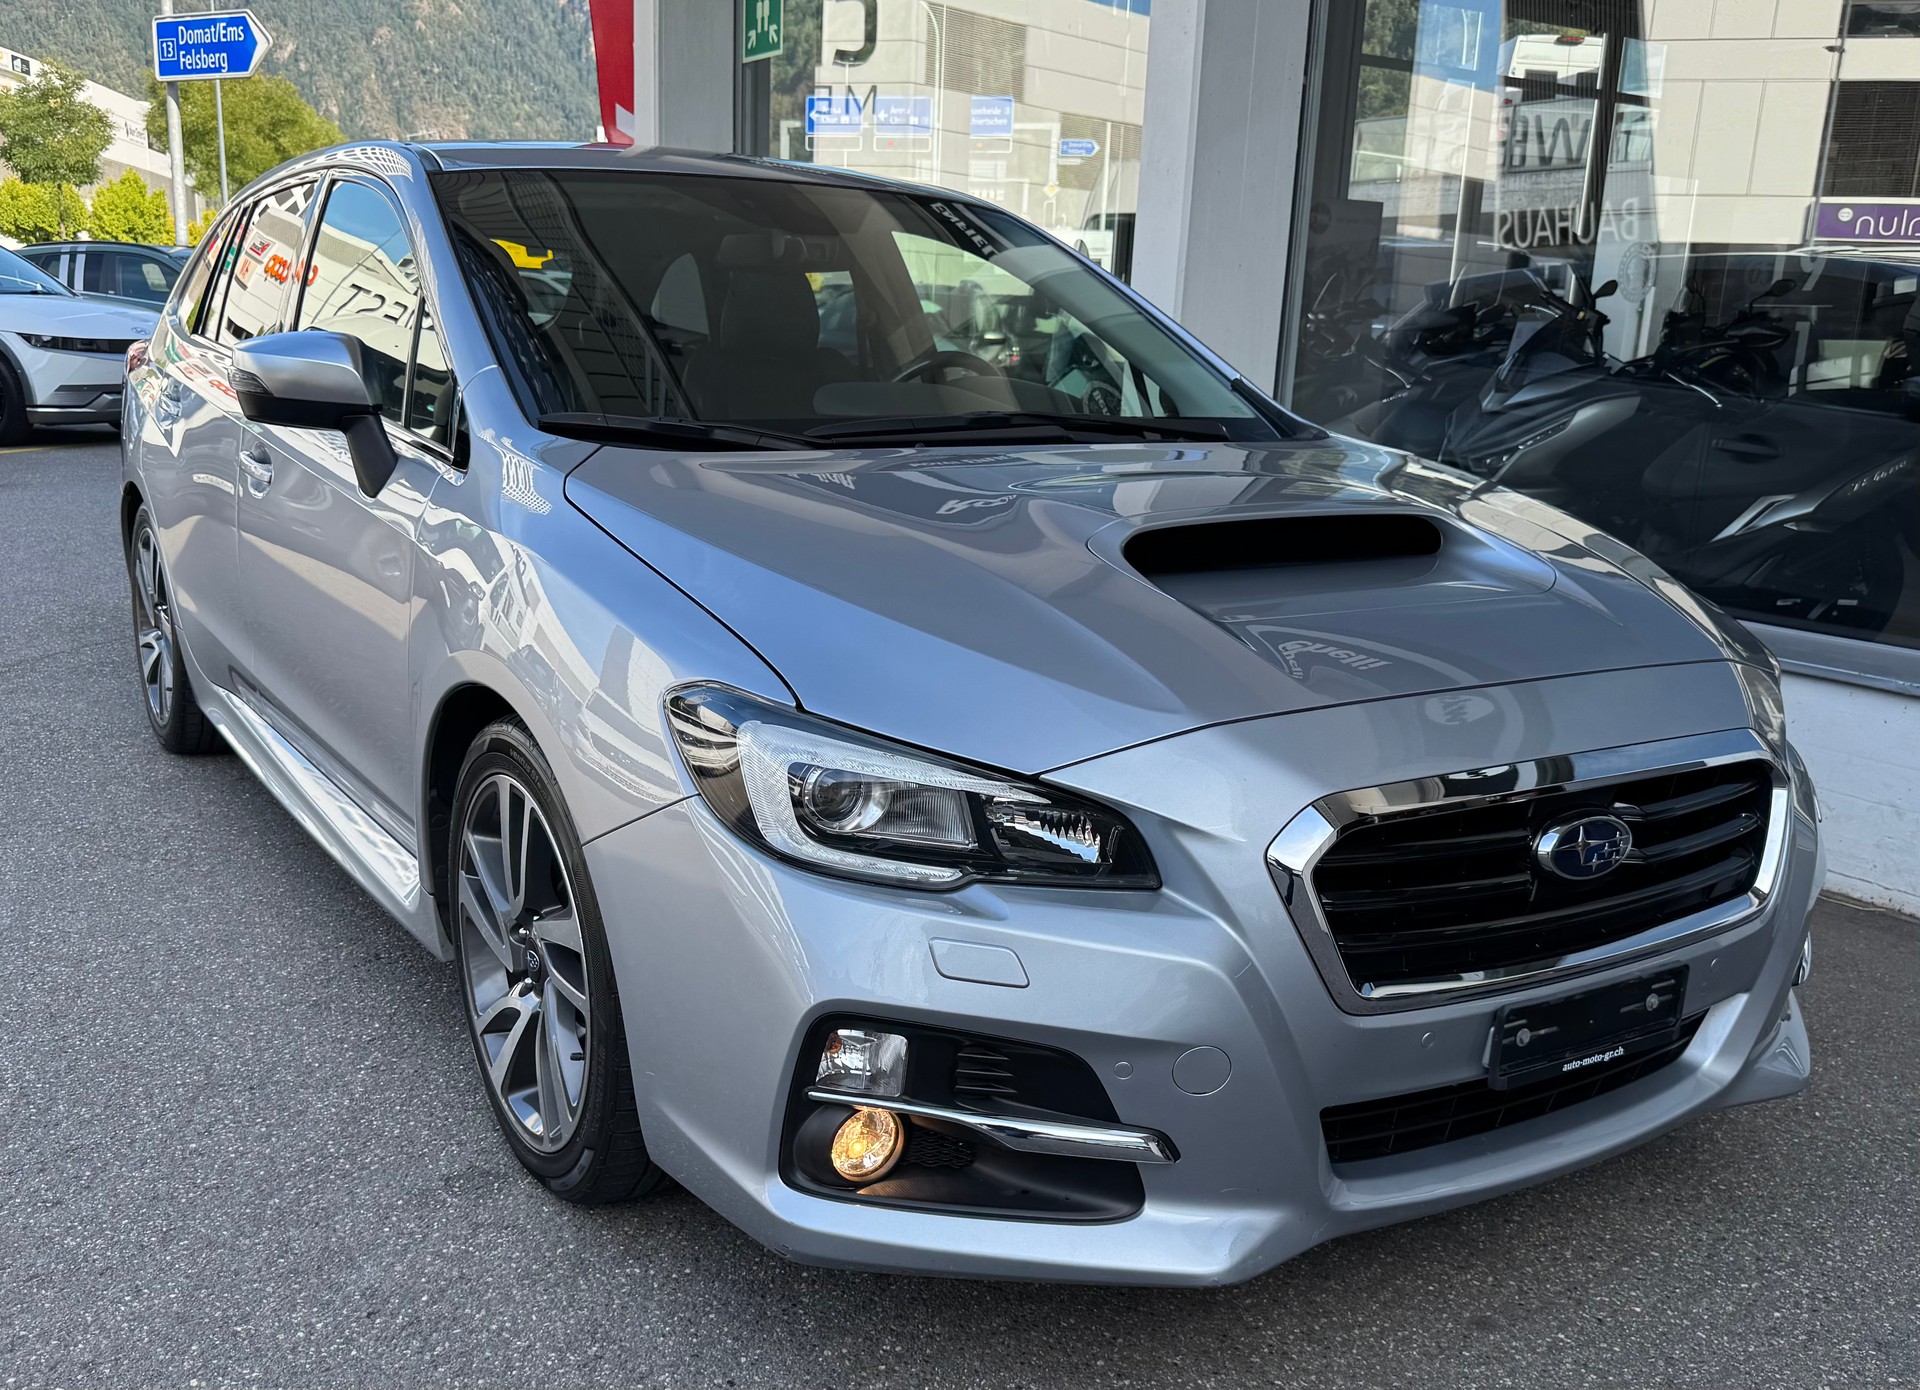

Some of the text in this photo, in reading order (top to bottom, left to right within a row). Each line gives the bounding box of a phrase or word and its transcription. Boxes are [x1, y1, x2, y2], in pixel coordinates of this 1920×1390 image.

[178, 22, 245, 45] Domat/Ems
[162, 42, 174, 58] 13
[179, 48, 229, 73] Felsberg
[1562, 1046, 1624, 1072] auto-moto-gr.ch
